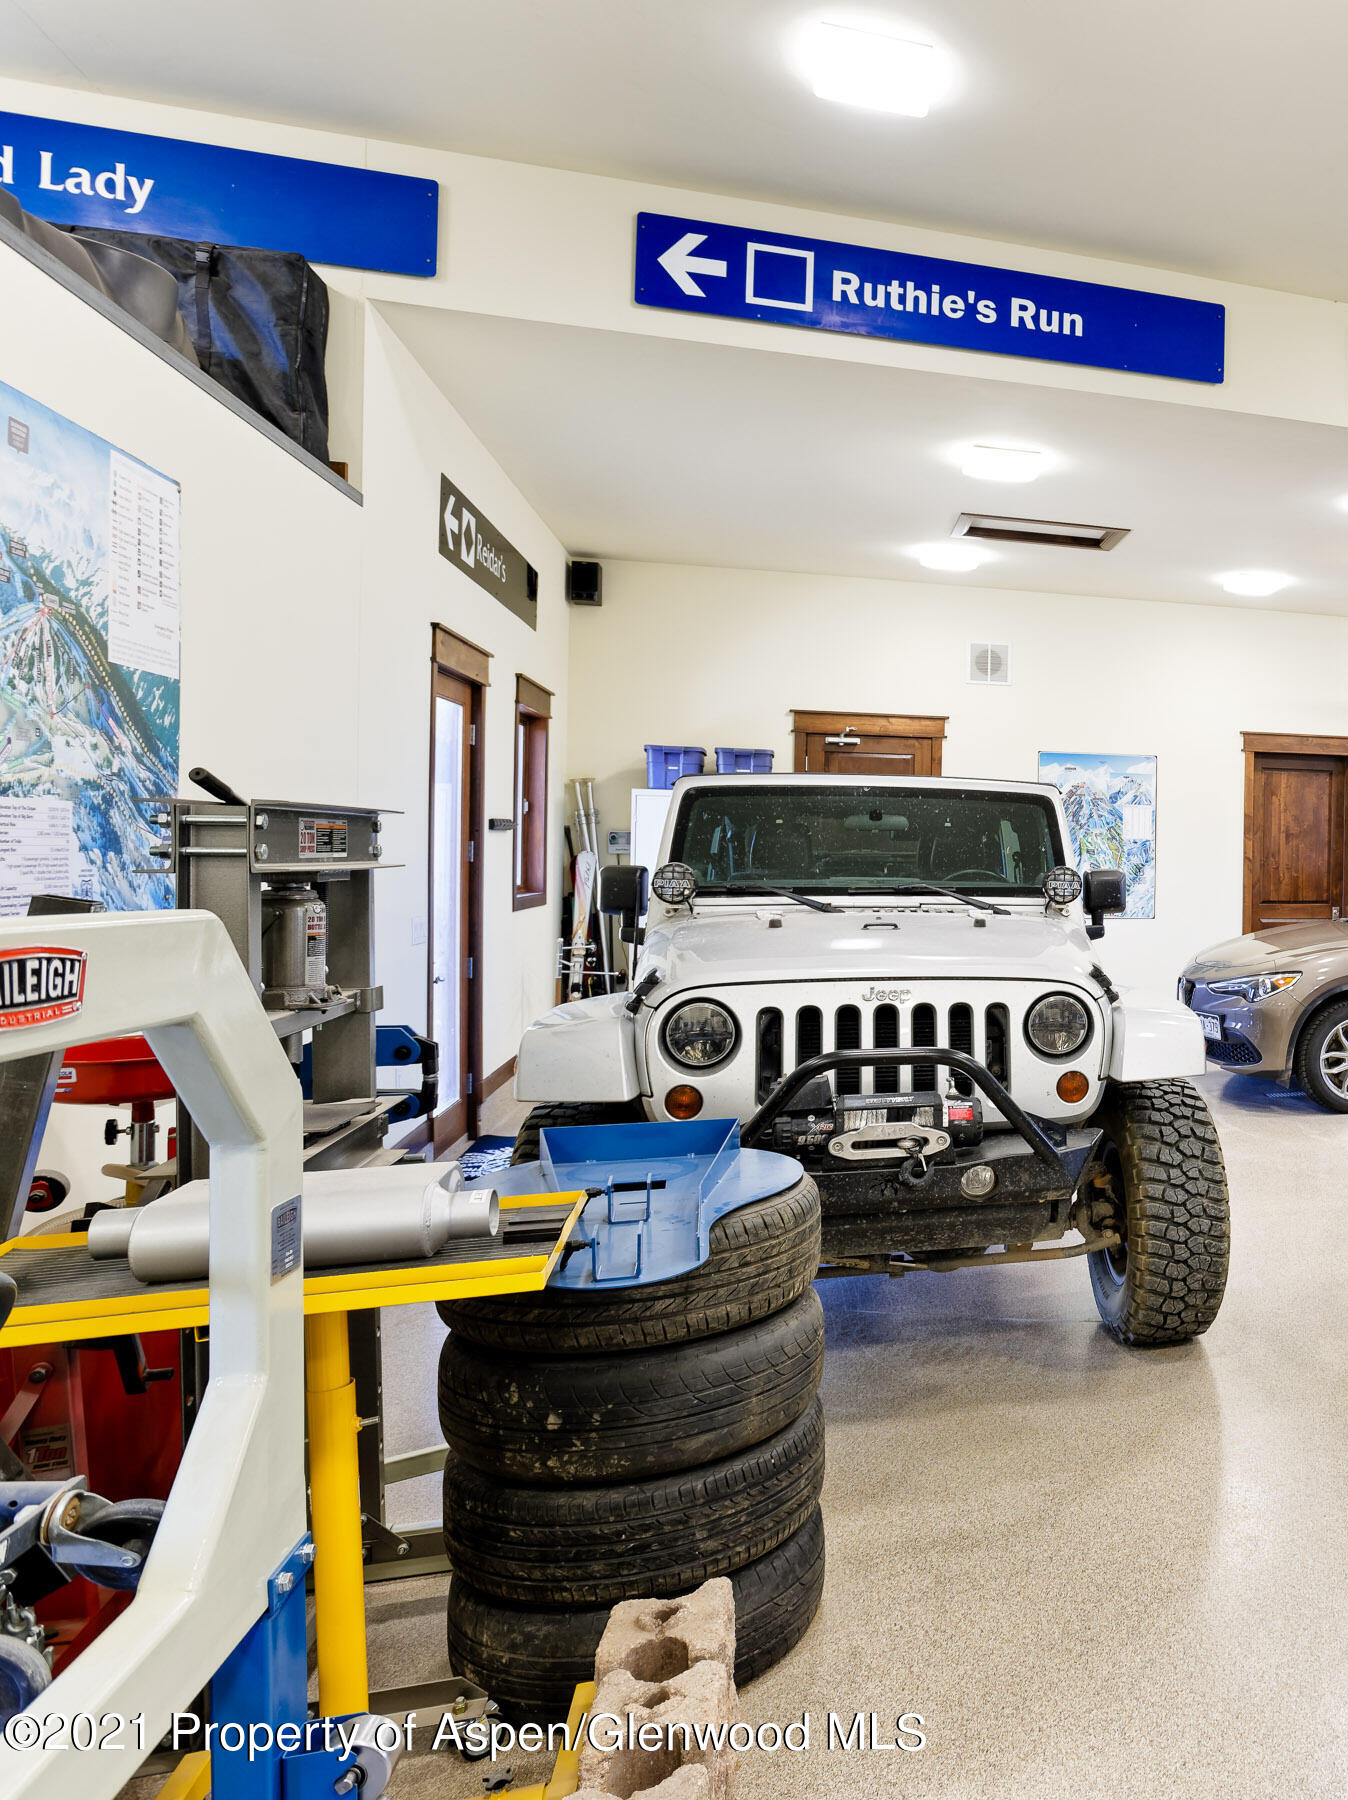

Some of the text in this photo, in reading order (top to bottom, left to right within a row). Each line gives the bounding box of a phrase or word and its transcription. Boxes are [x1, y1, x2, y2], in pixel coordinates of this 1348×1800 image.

[38, 151, 155, 214] Lady
[832, 269, 1084, 337] Ruthie's Run
[476, 533, 507, 583] Reidar's
[654, 879, 690, 888] PIAA
[1049, 880, 1080, 889] PIAA
[0, 958, 80, 1007] ILEIGH
[862, 986, 912, 1004] Jeep
